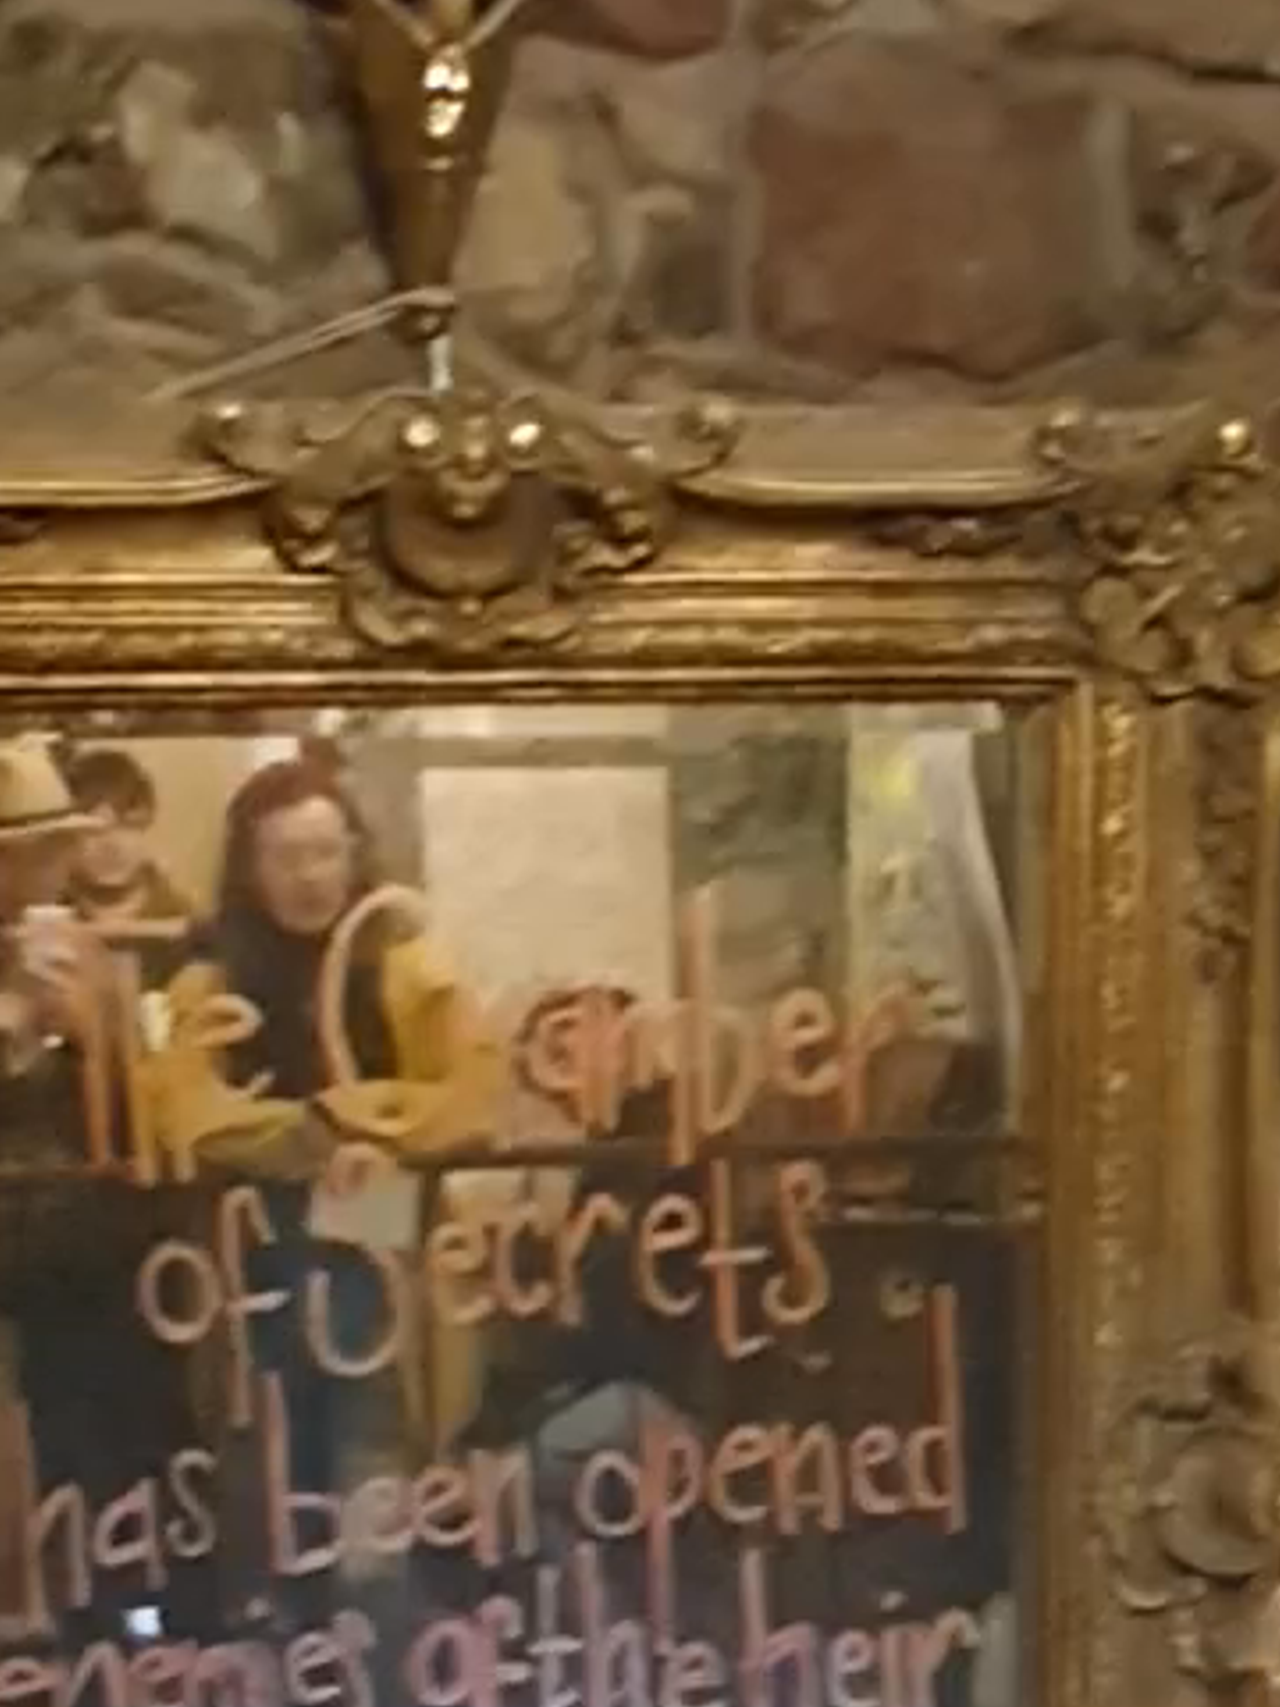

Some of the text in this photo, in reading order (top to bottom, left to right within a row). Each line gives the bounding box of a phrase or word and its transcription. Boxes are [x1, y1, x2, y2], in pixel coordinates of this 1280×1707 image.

[136, 1141, 828, 1428] of Secrets
[12, 1283, 970, 1663] has been opened
